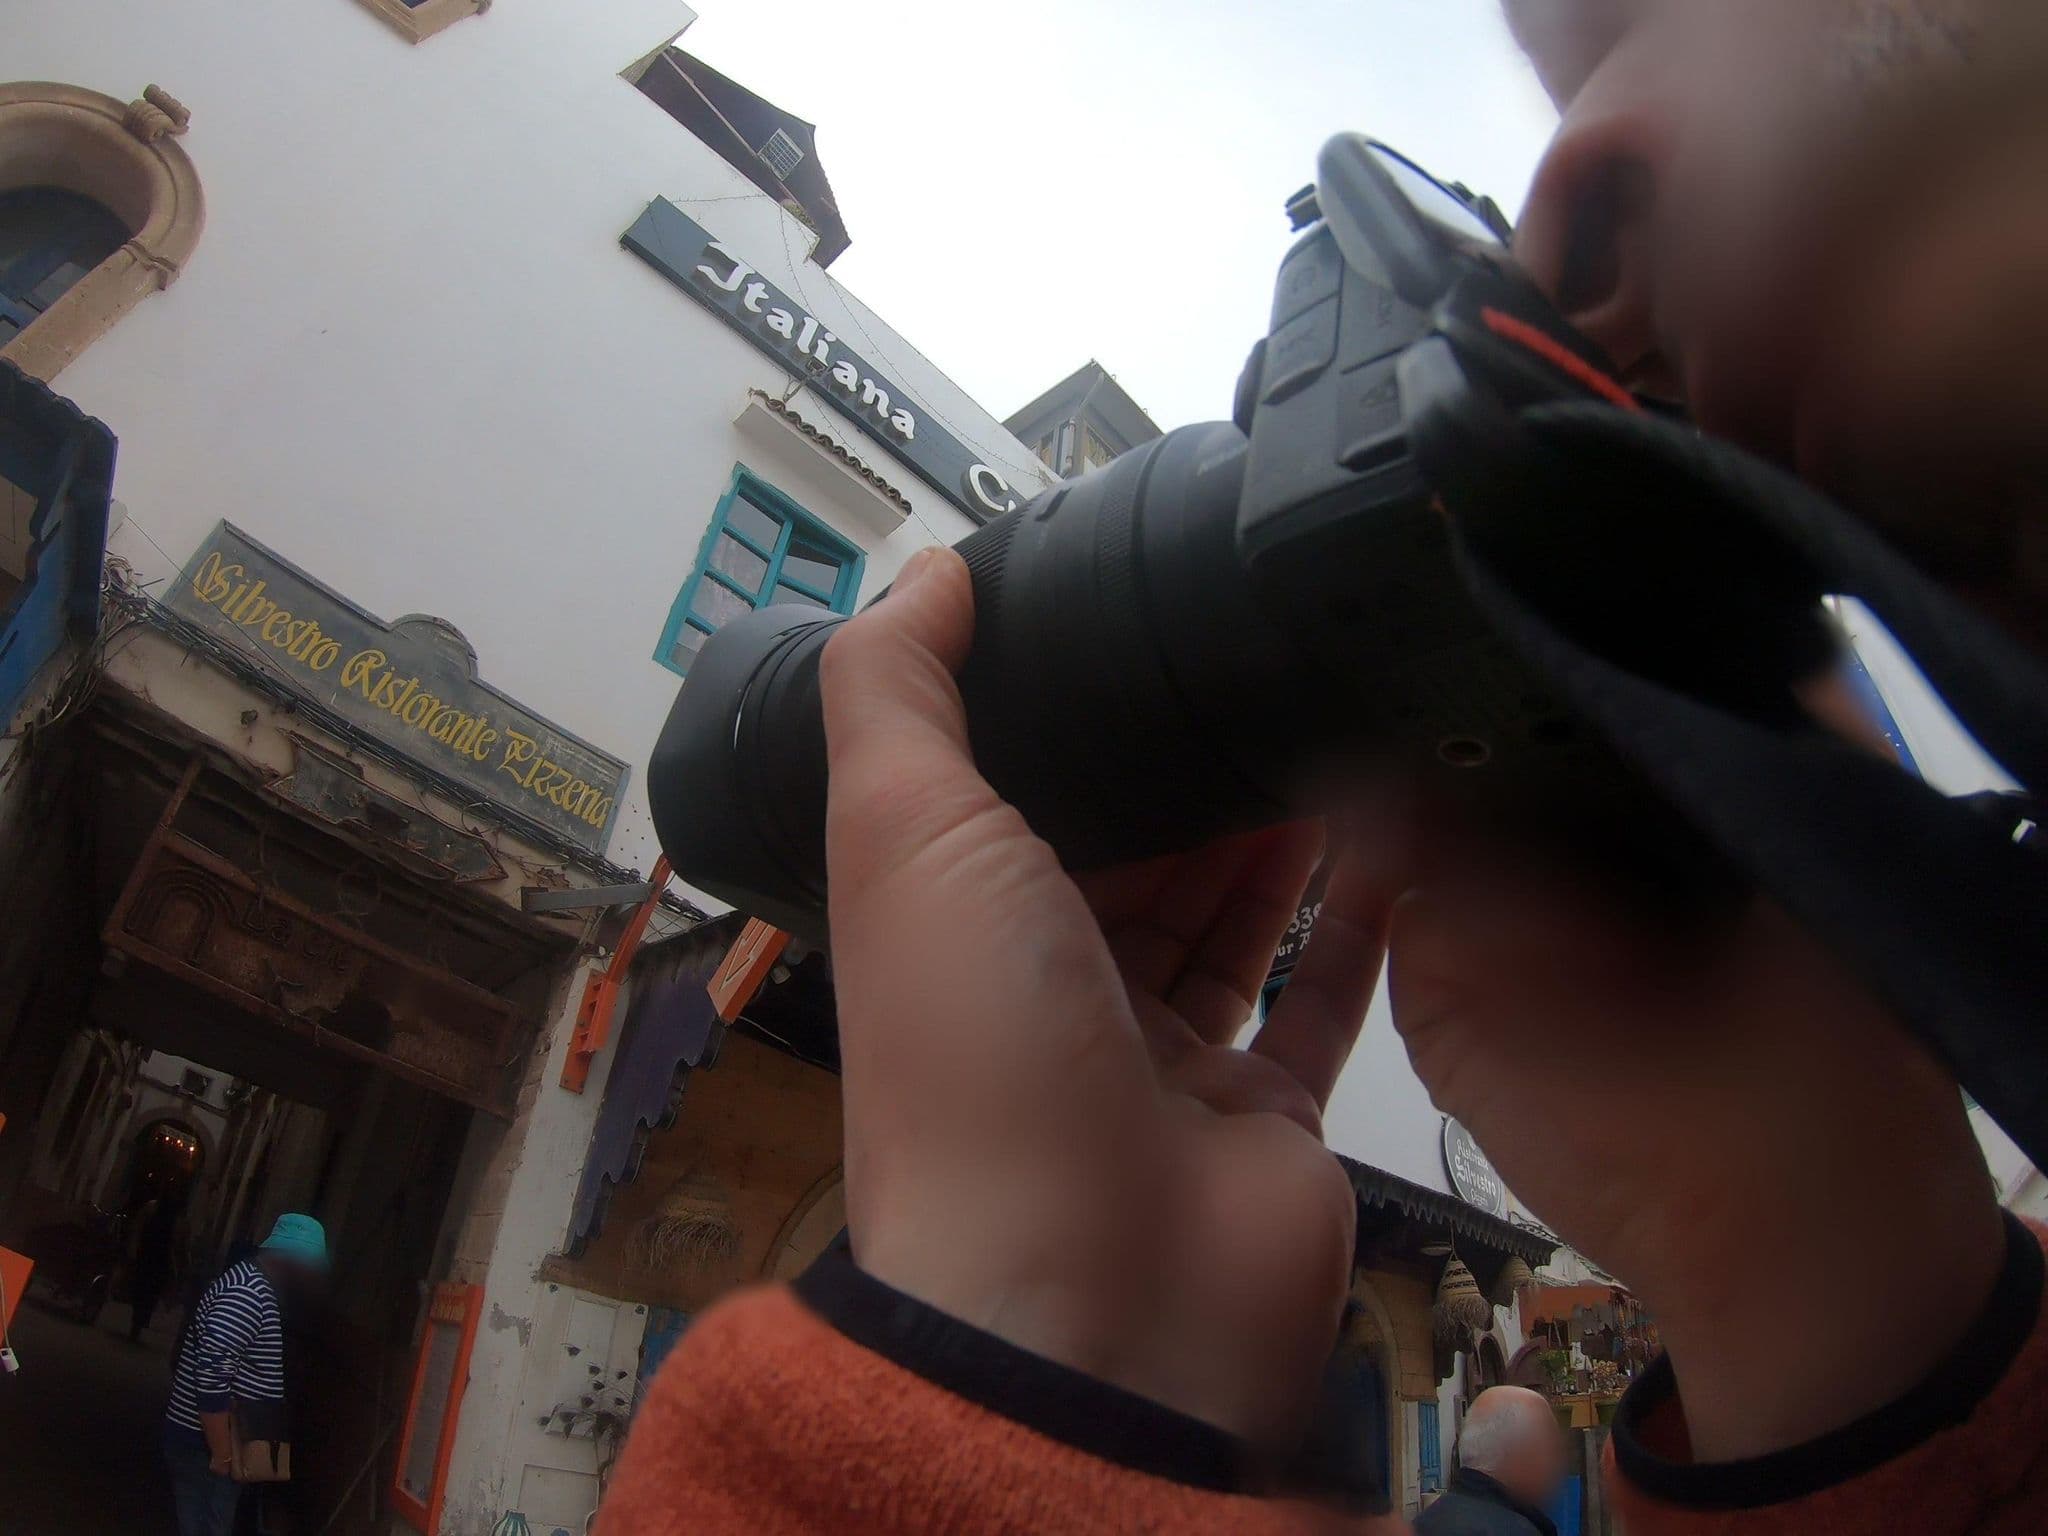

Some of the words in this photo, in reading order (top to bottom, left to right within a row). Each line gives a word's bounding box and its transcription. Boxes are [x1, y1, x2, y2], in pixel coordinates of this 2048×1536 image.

[968, 463, 1016, 512] C
[192, 551, 341, 671] Silvestro
[340, 649, 498, 761] Ristorante
[496, 726, 614, 828] Pizzeria
